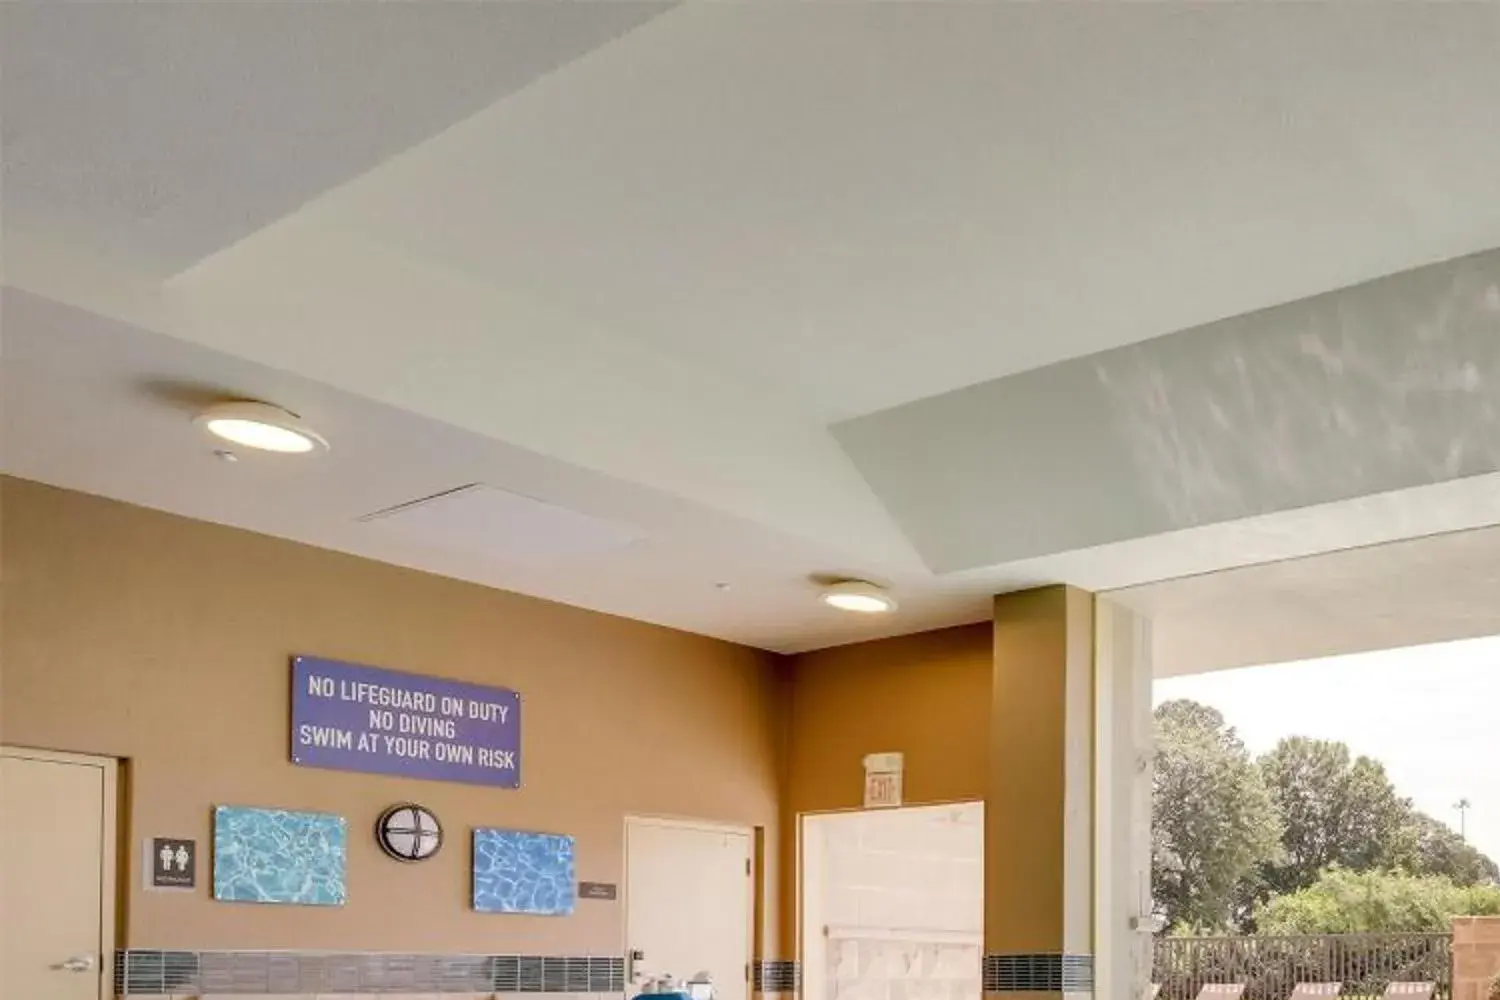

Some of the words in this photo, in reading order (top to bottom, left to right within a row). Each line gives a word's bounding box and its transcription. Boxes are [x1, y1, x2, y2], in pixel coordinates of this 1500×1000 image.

[308, 675, 334, 697] NO
[340, 679, 435, 713] LIFEGUARD
[441, 697, 464, 718] ON
[469, 700, 509, 725] DUTY
[369, 709, 393, 731] NO
[399, 713, 455, 739] DIVING
[300, 724, 352, 750] SWIM
[357, 732, 379, 753] AT
[383, 735, 430, 759] YOUR
[435, 742, 473, 766] OWN
[477, 747, 516, 770] RISK
[870, 776, 897, 802] EXIT
